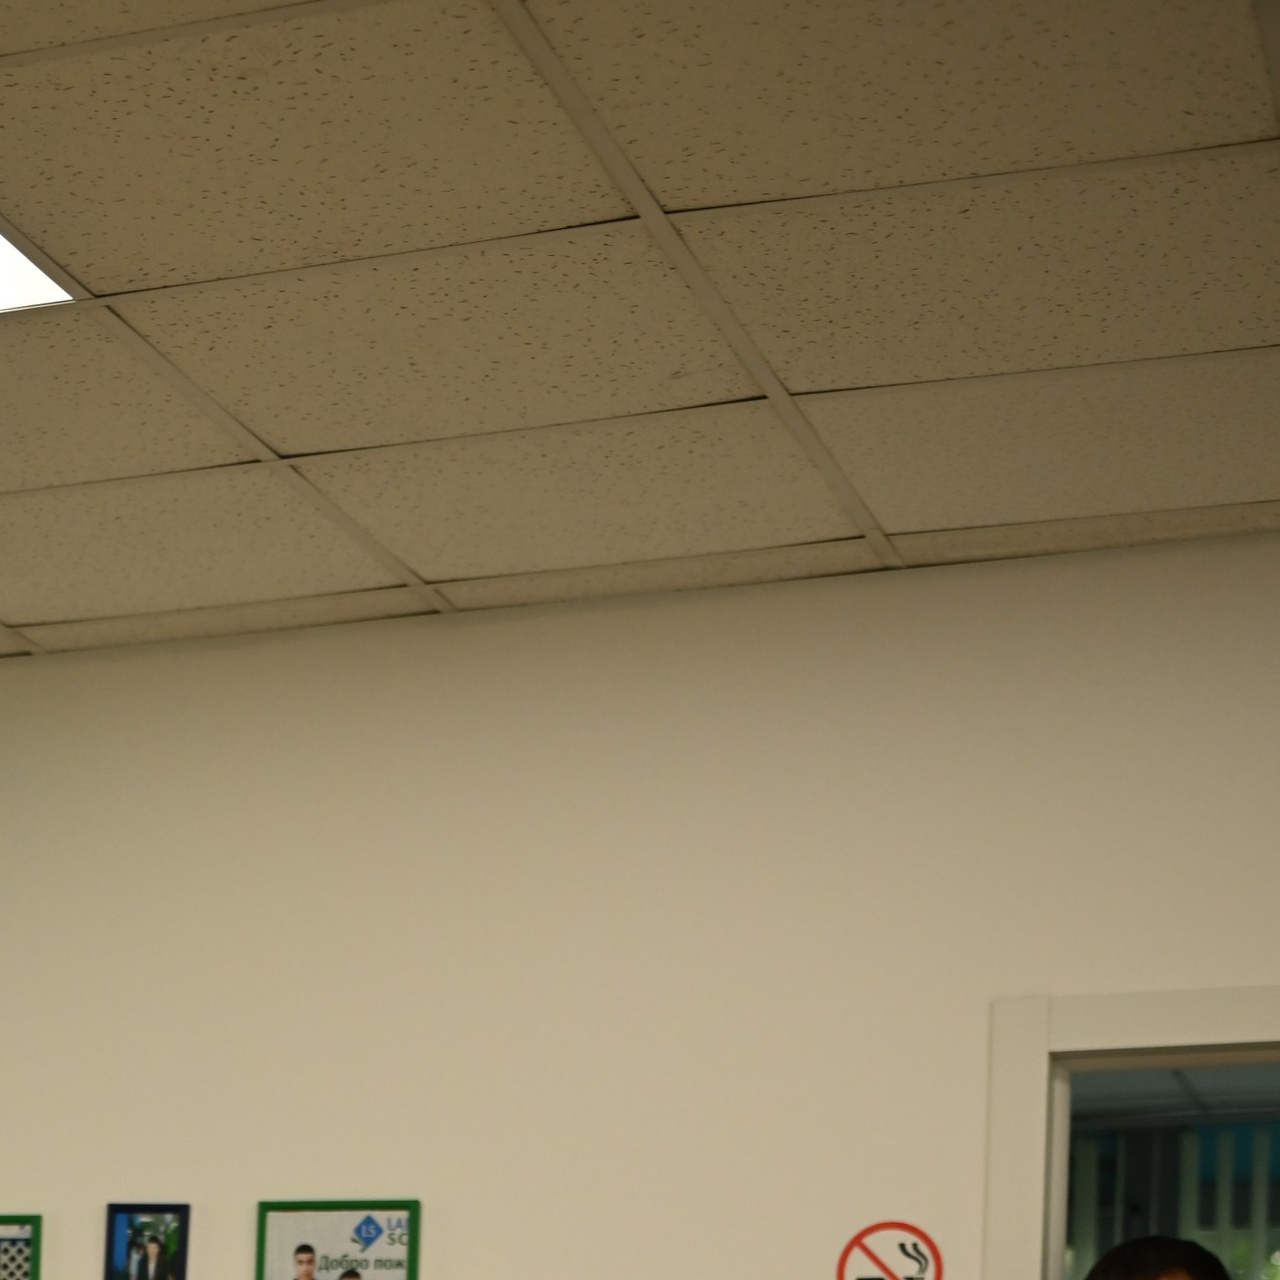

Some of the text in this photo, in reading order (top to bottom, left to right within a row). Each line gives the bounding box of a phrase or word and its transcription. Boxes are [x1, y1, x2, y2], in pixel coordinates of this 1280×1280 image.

[361, 1225, 377, 1238] LS
[387, 1232, 408, 1246] SC
[318, 1253, 370, 1273] Добро
